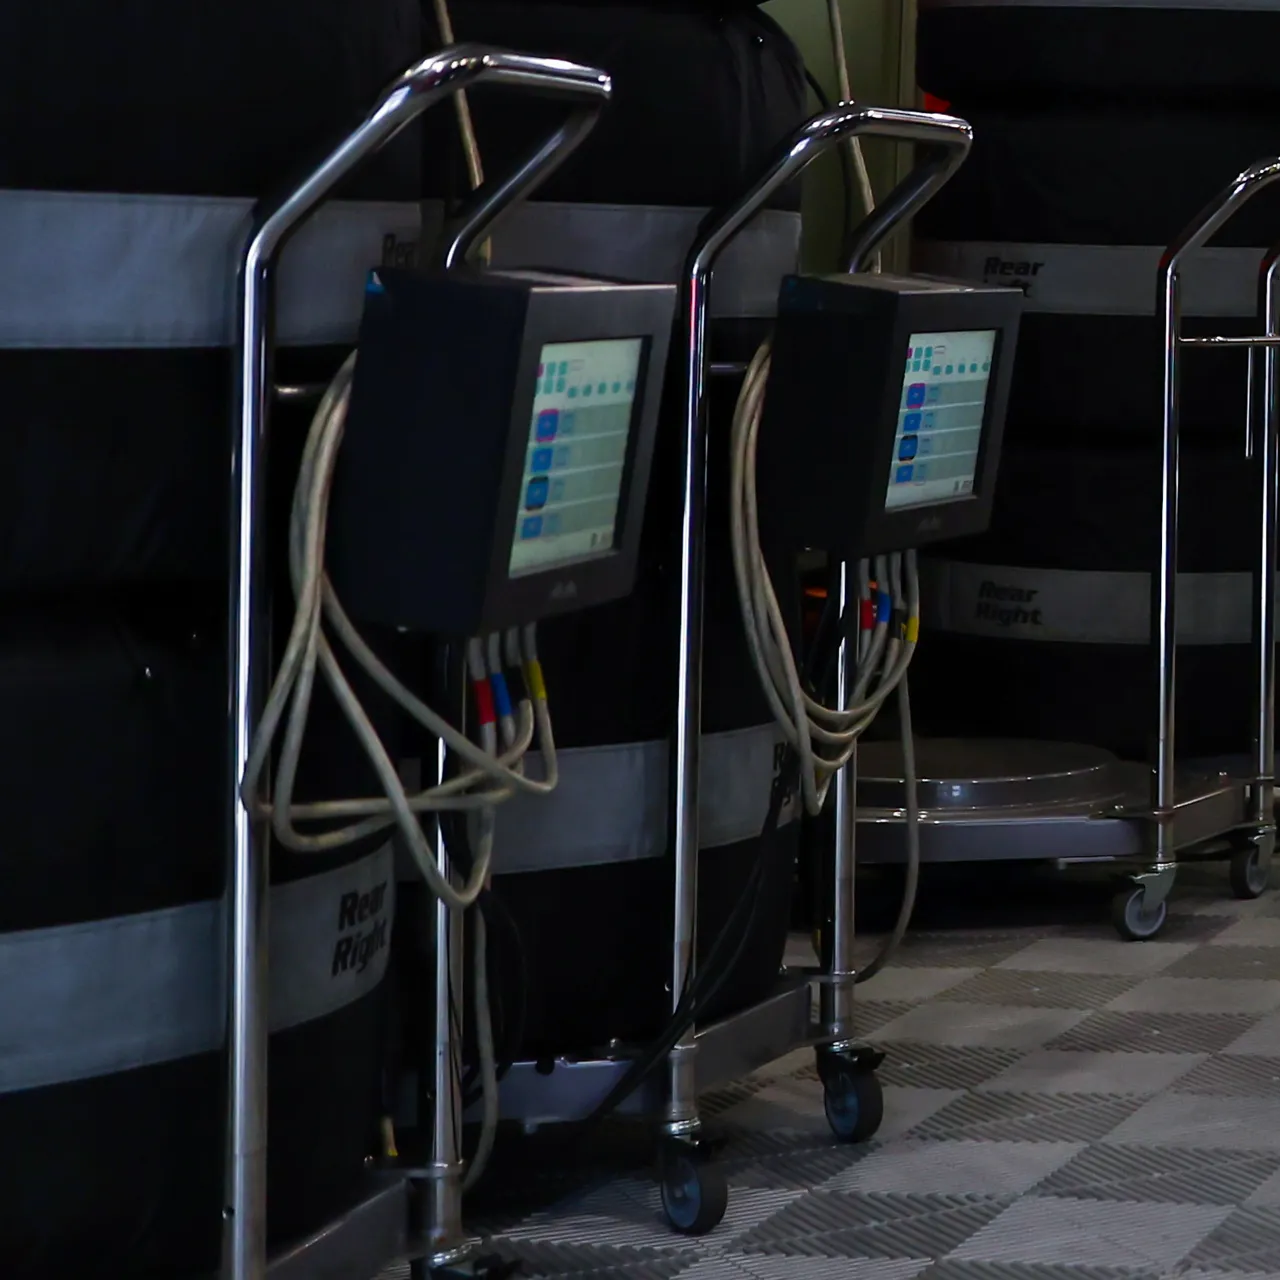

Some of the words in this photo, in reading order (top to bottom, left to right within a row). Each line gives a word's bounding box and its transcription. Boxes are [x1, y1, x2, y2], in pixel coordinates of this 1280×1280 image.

[984, 256, 1045, 276] Rear
[978, 581, 1039, 603] Rear
[974, 602, 1044, 627] Right
